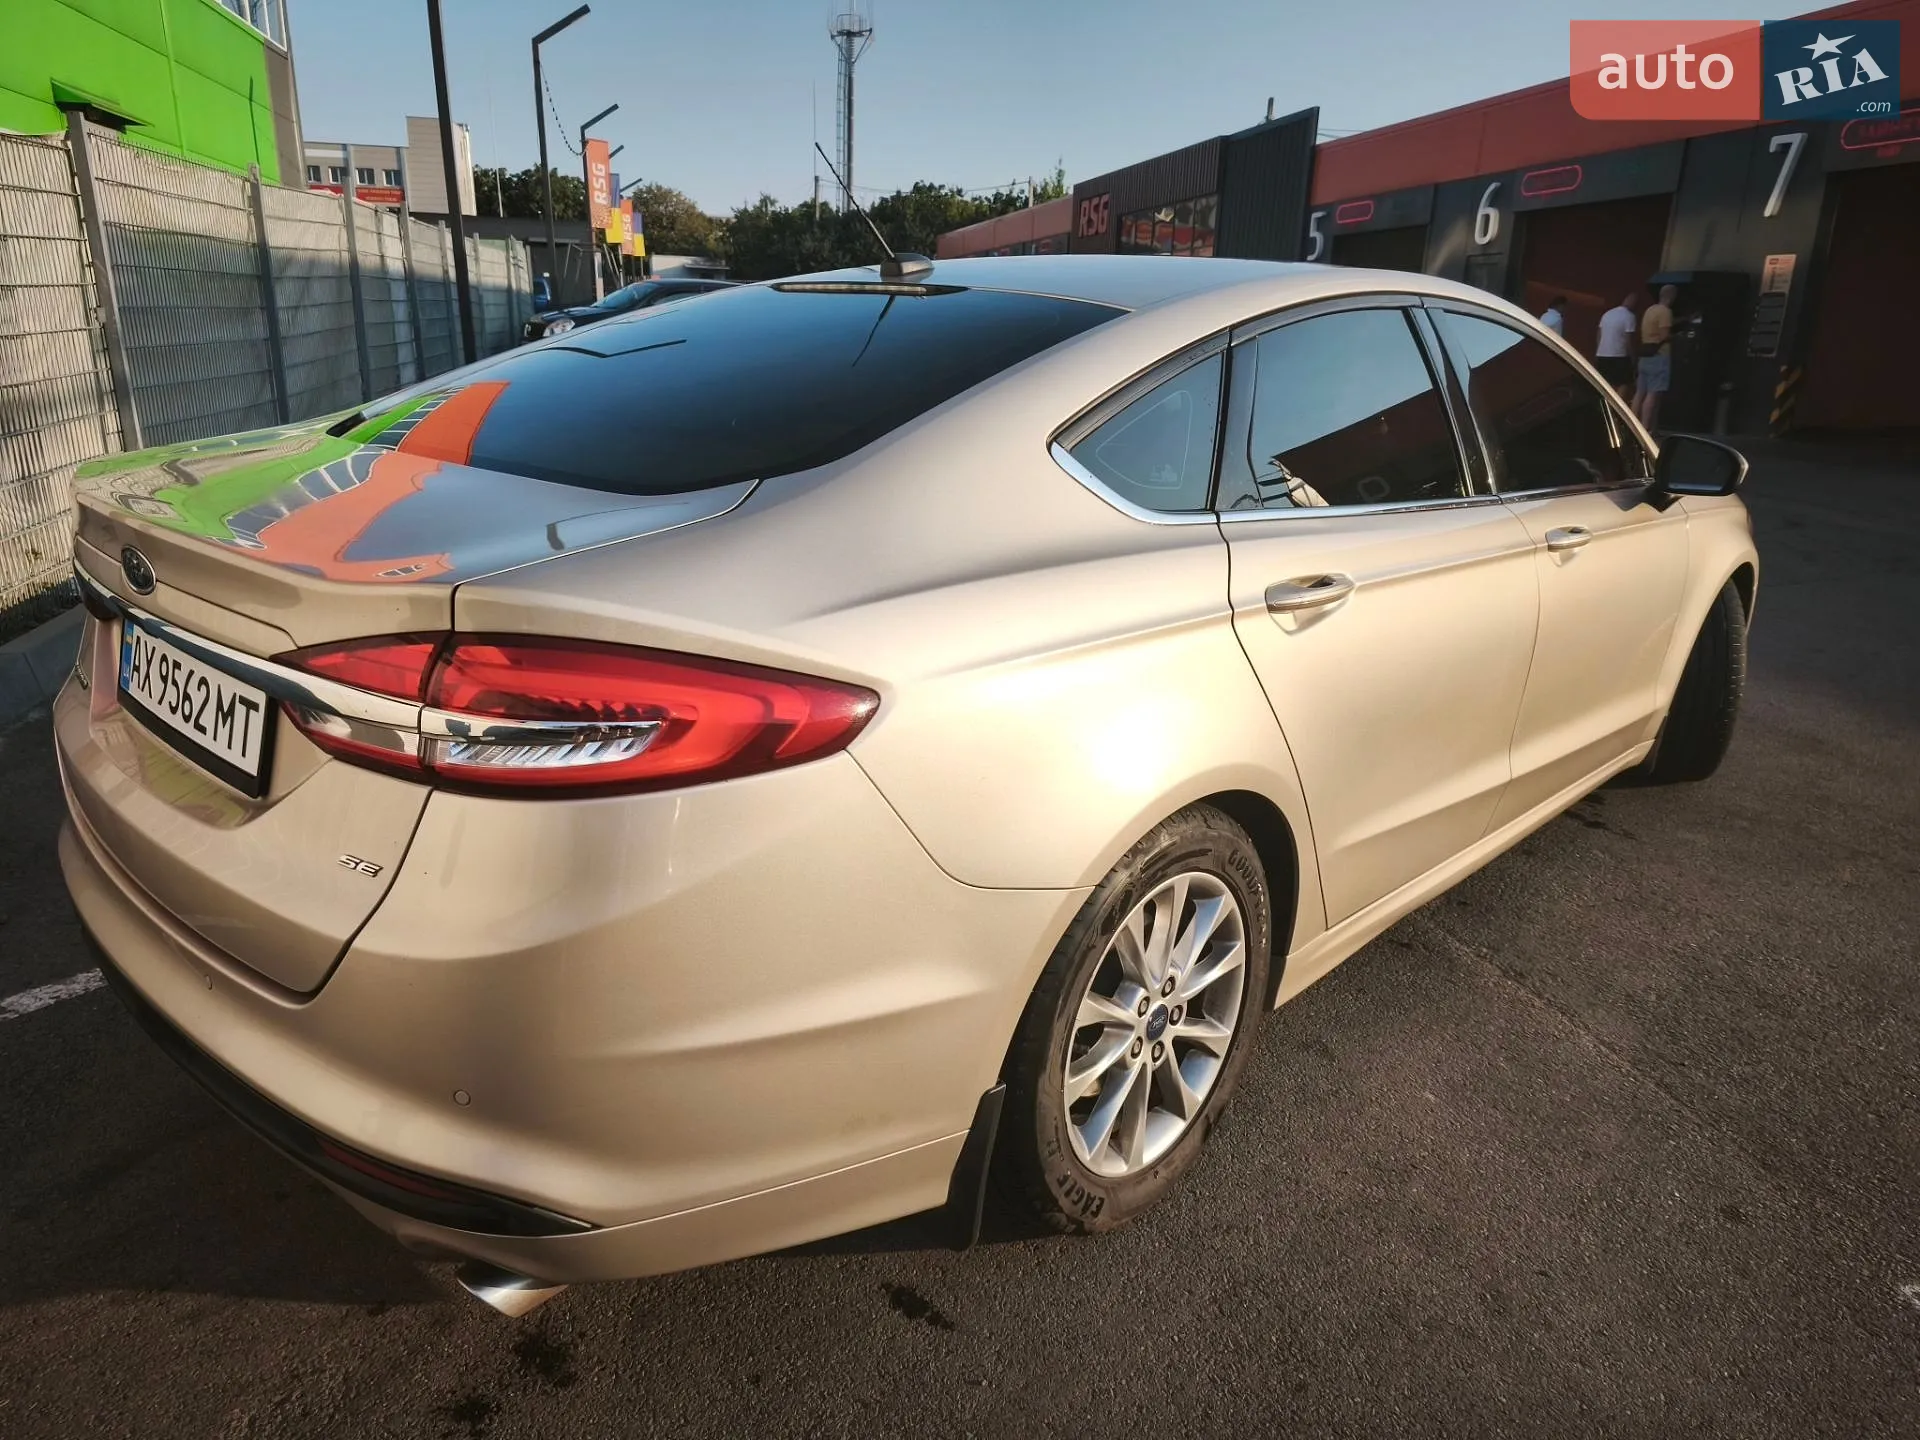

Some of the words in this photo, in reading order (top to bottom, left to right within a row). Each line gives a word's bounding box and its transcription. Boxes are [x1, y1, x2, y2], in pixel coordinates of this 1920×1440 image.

[592, 163, 609, 205] RSG
[1763, 132, 1808, 218] 7
[1078, 193, 1109, 238] RSG
[1306, 211, 1327, 261] 5
[1474, 182, 1501, 245] 6
[159, 653, 210, 736] 9562
[336, 854, 384, 878] SE
